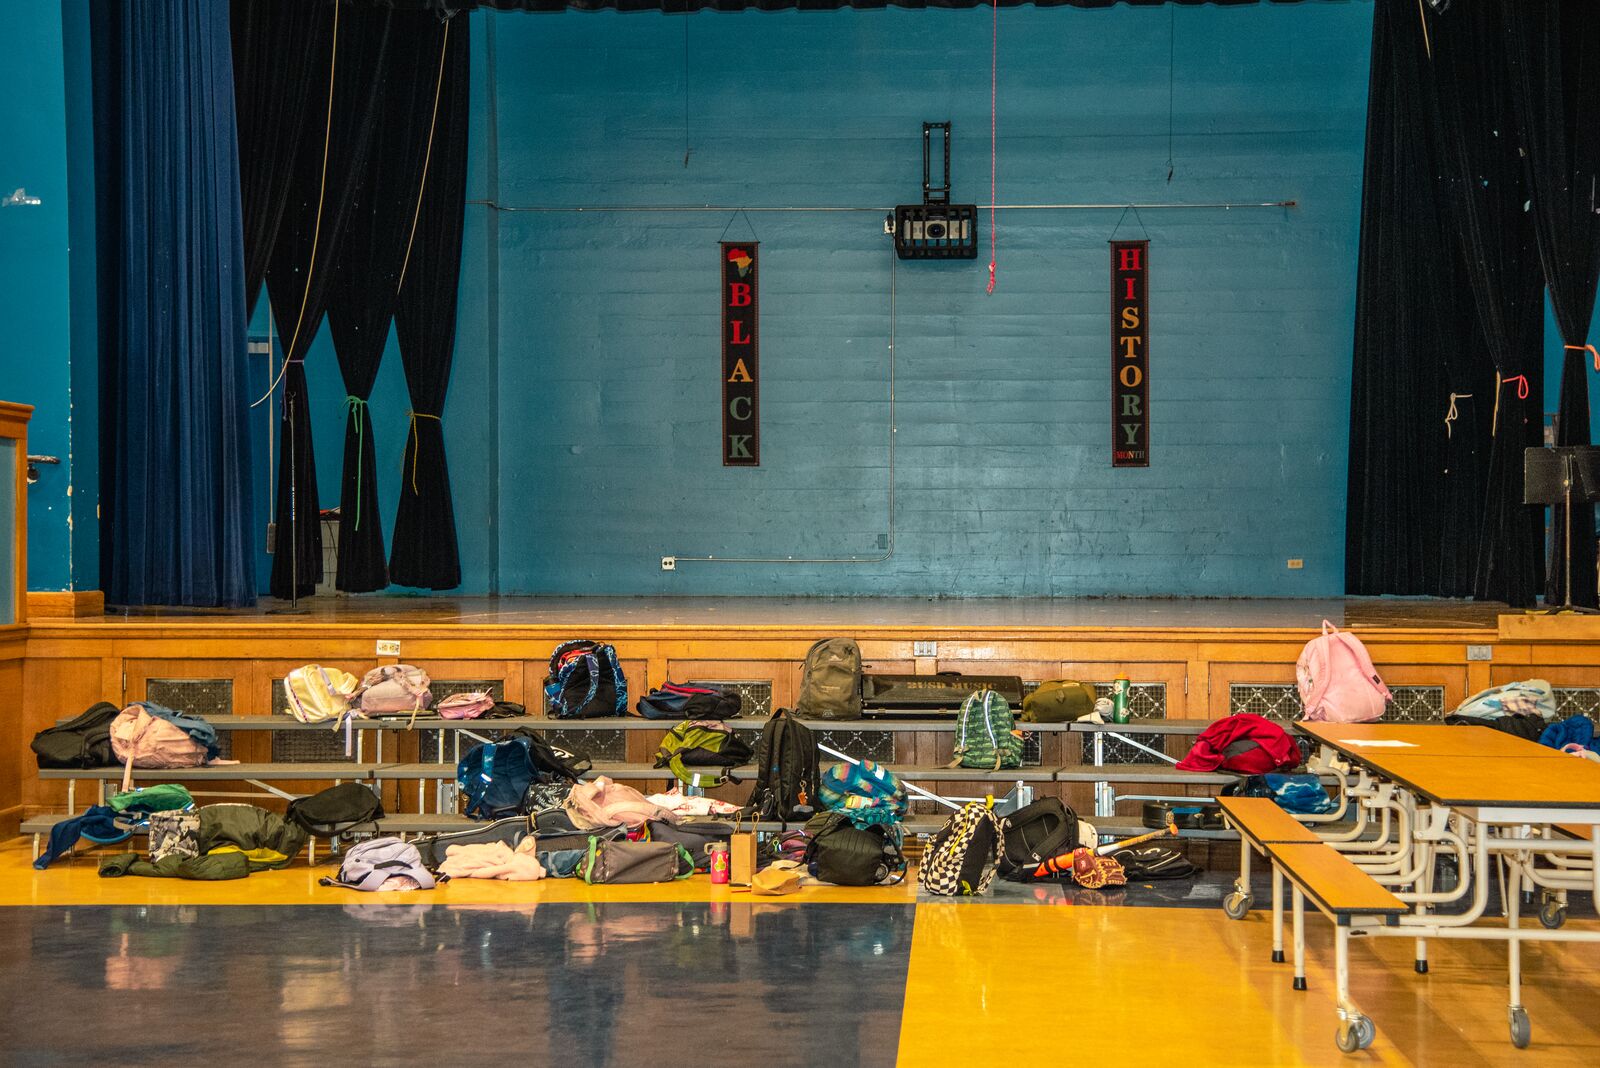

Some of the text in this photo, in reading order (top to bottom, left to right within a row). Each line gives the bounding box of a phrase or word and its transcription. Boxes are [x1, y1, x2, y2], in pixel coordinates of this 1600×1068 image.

[728, 282, 754, 458] BLACK
[1118, 249, 1143, 445] HISTORY
[1115, 450, 1145, 459] MONTH
